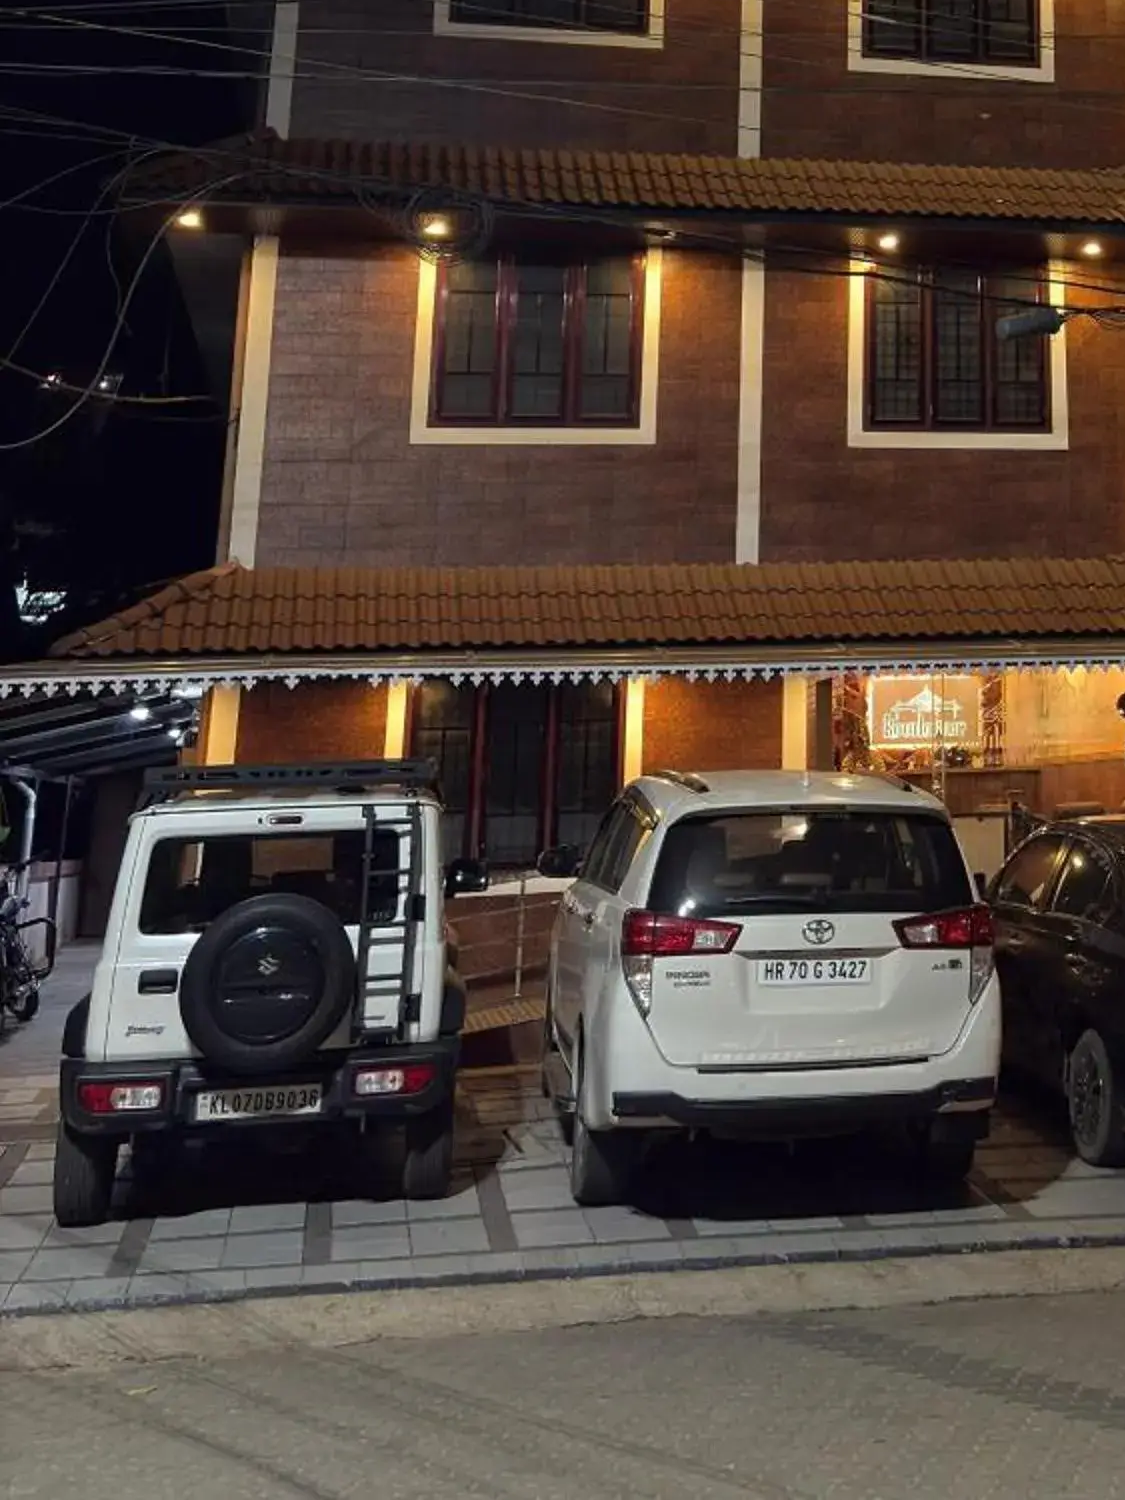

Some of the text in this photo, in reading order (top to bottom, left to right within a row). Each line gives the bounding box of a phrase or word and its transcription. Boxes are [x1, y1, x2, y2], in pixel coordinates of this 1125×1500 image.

[763, 960, 868, 980] HR 70 G 3427
